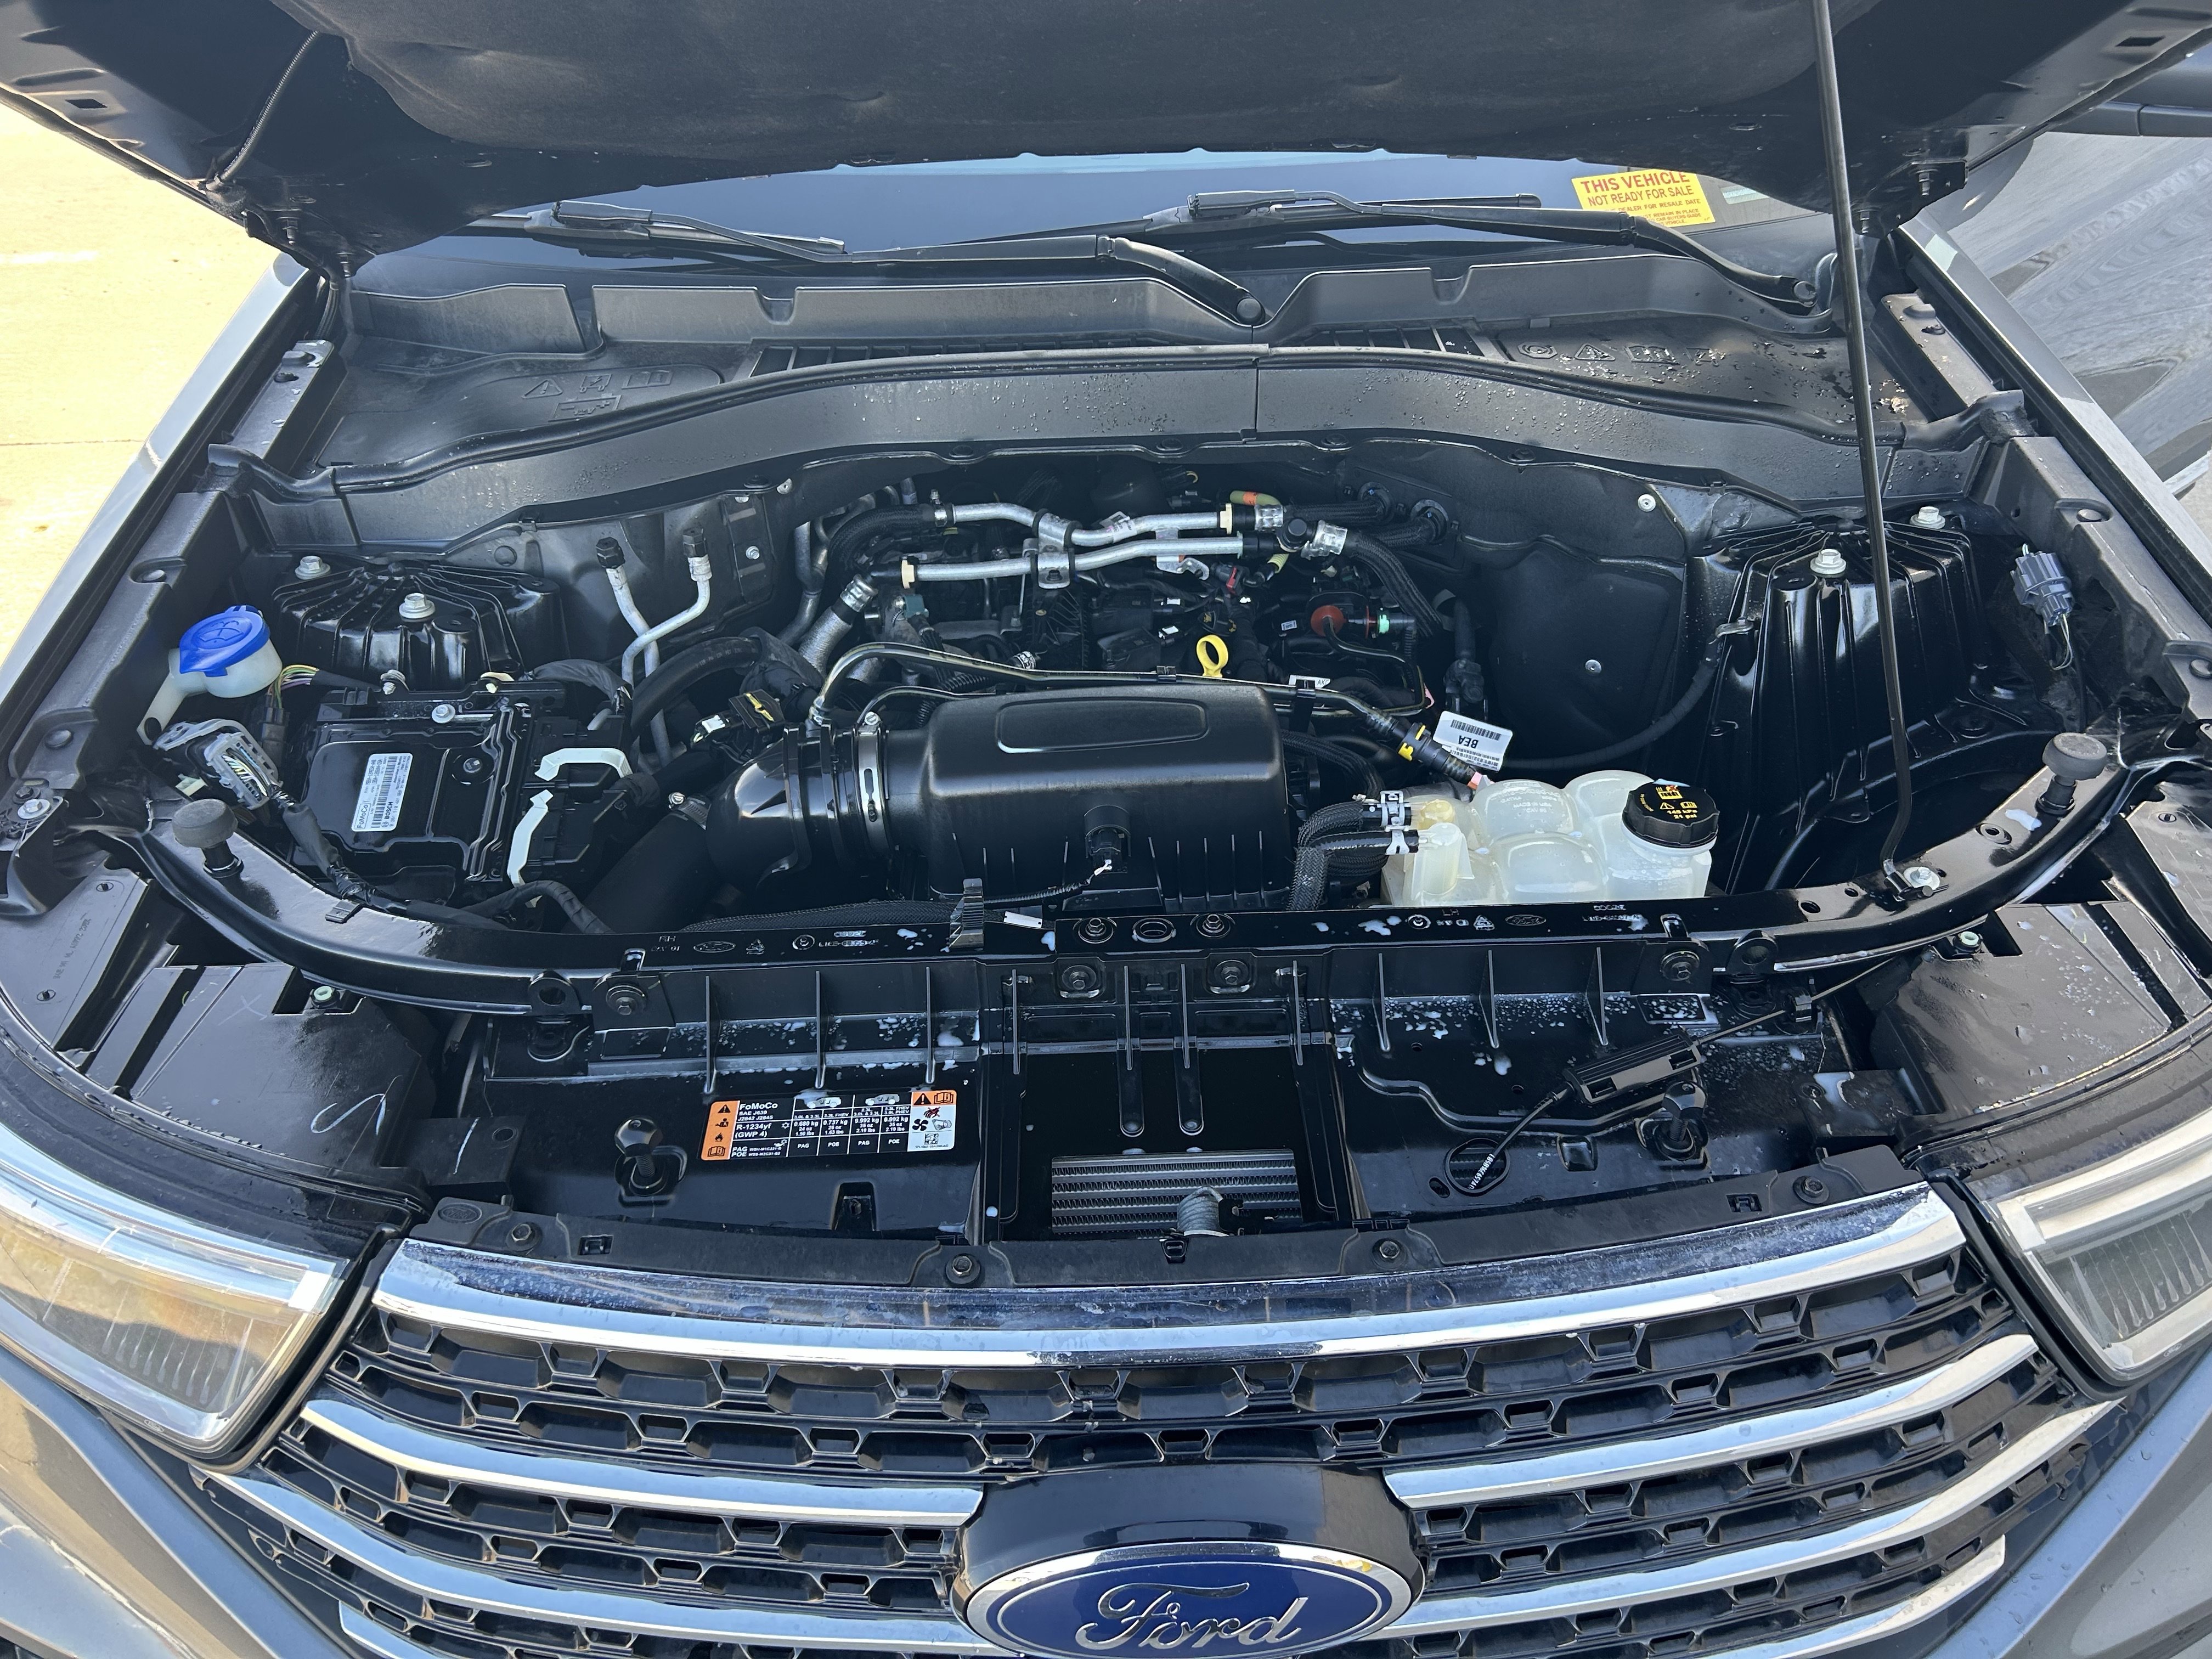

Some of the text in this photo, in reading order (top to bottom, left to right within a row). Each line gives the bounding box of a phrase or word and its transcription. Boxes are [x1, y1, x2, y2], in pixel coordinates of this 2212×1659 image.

[1581, 171, 1690, 193] THIS VEHICLE
[1588, 185, 1694, 206] NOT READY FOR SALE
[1458, 735, 1479, 749] BEA
[357, 804, 368, 828] FoMoCo
[384, 802, 393, 819] BOSCH
[1075, 1582, 1308, 1650] Ford
